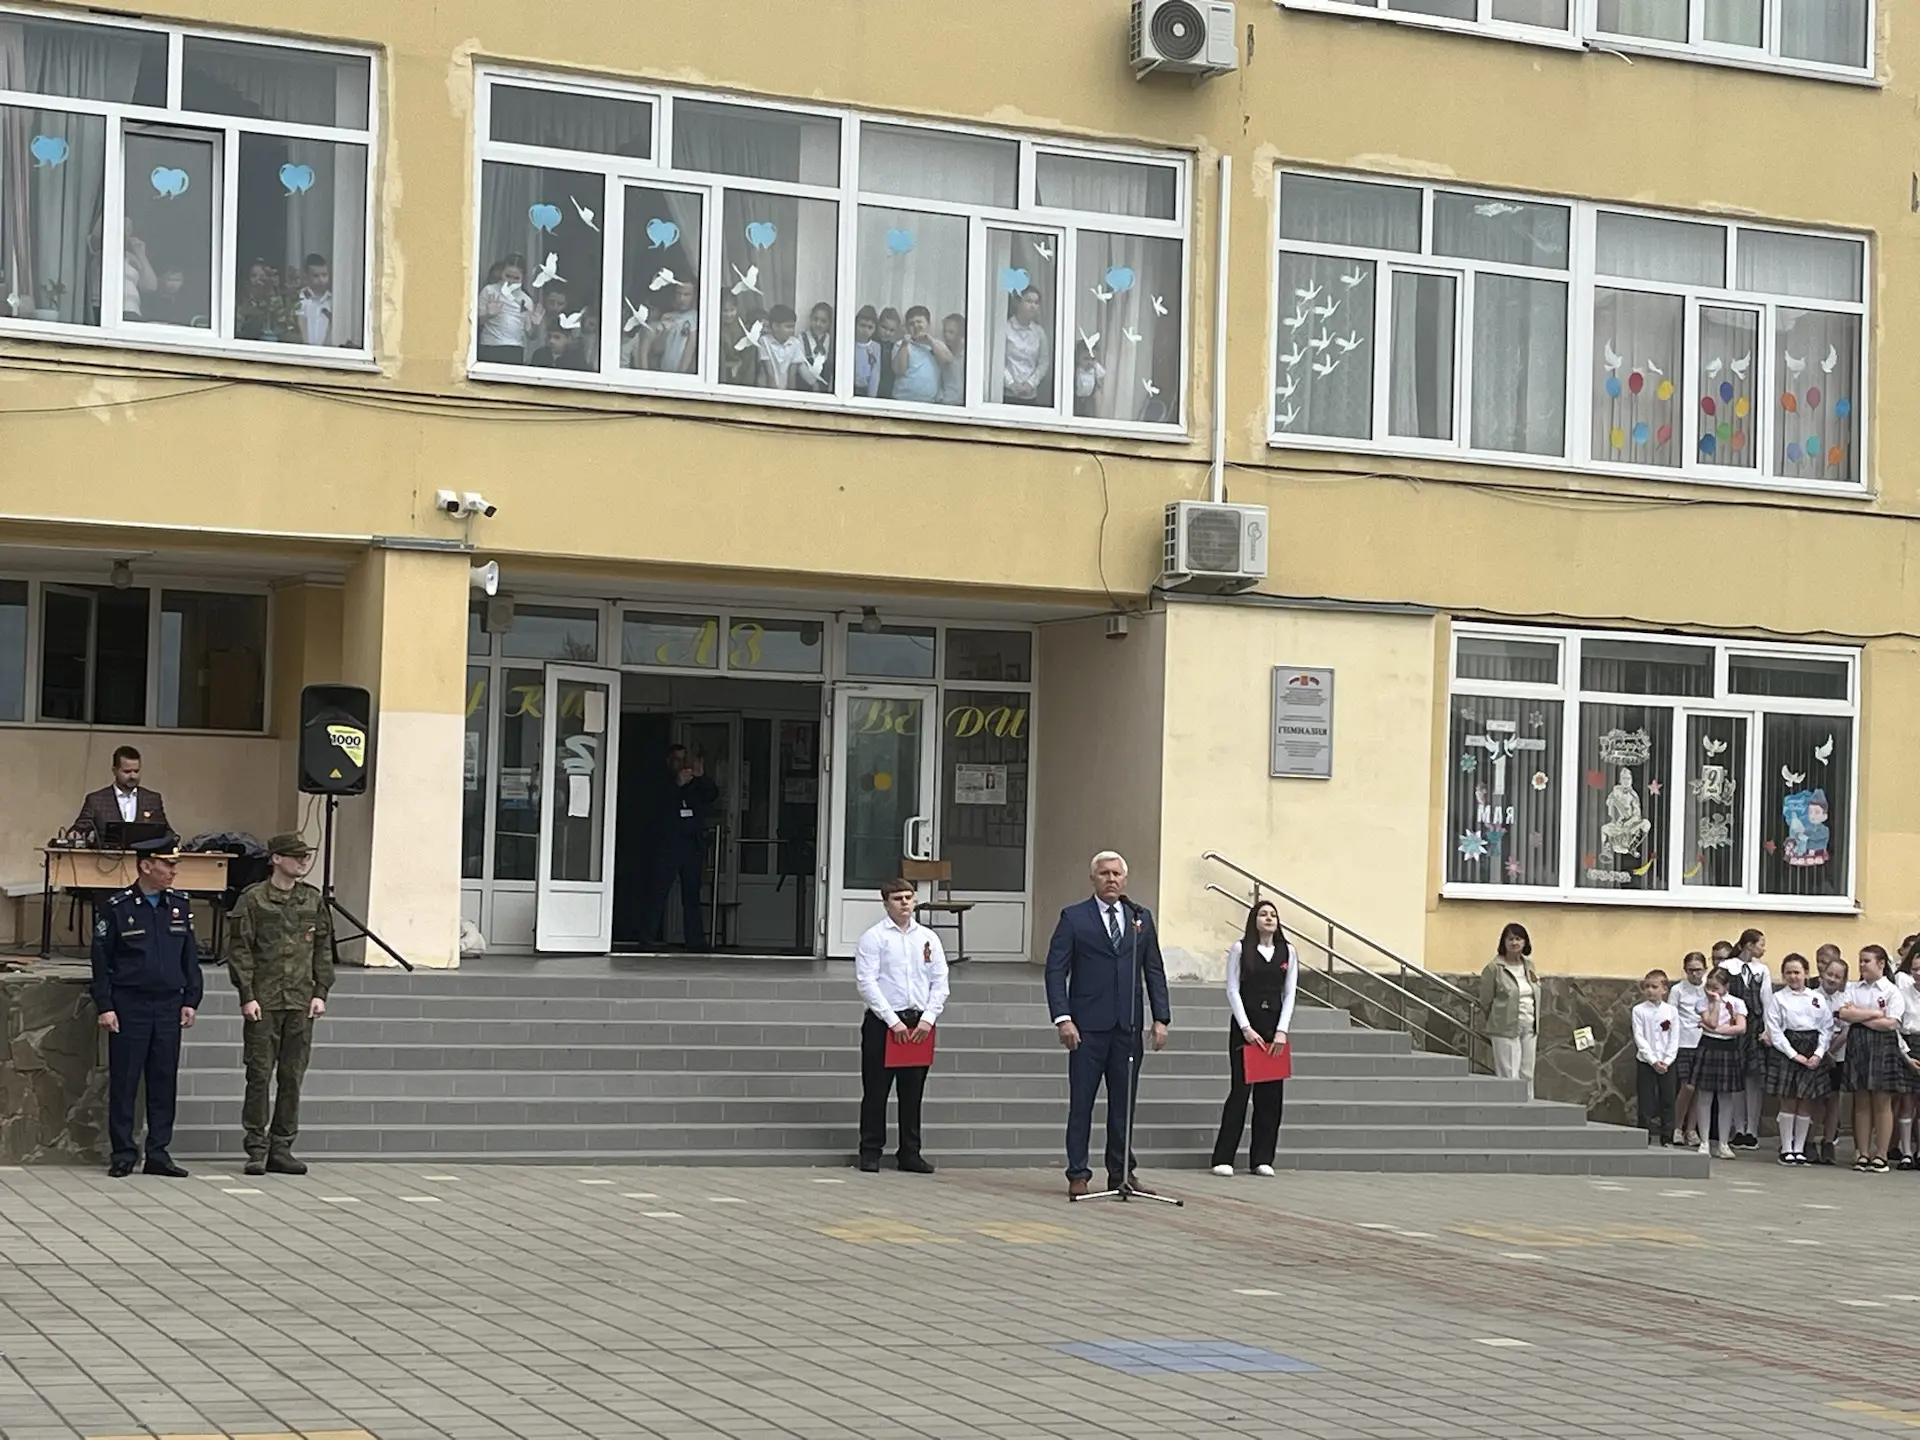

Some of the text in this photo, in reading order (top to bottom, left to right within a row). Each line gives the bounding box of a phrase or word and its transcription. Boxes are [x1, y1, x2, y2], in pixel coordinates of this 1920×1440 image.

[331, 734, 361, 746] 1000
[1492, 755, 1506, 795] 1
[1477, 804, 1515, 825] МАЯ
